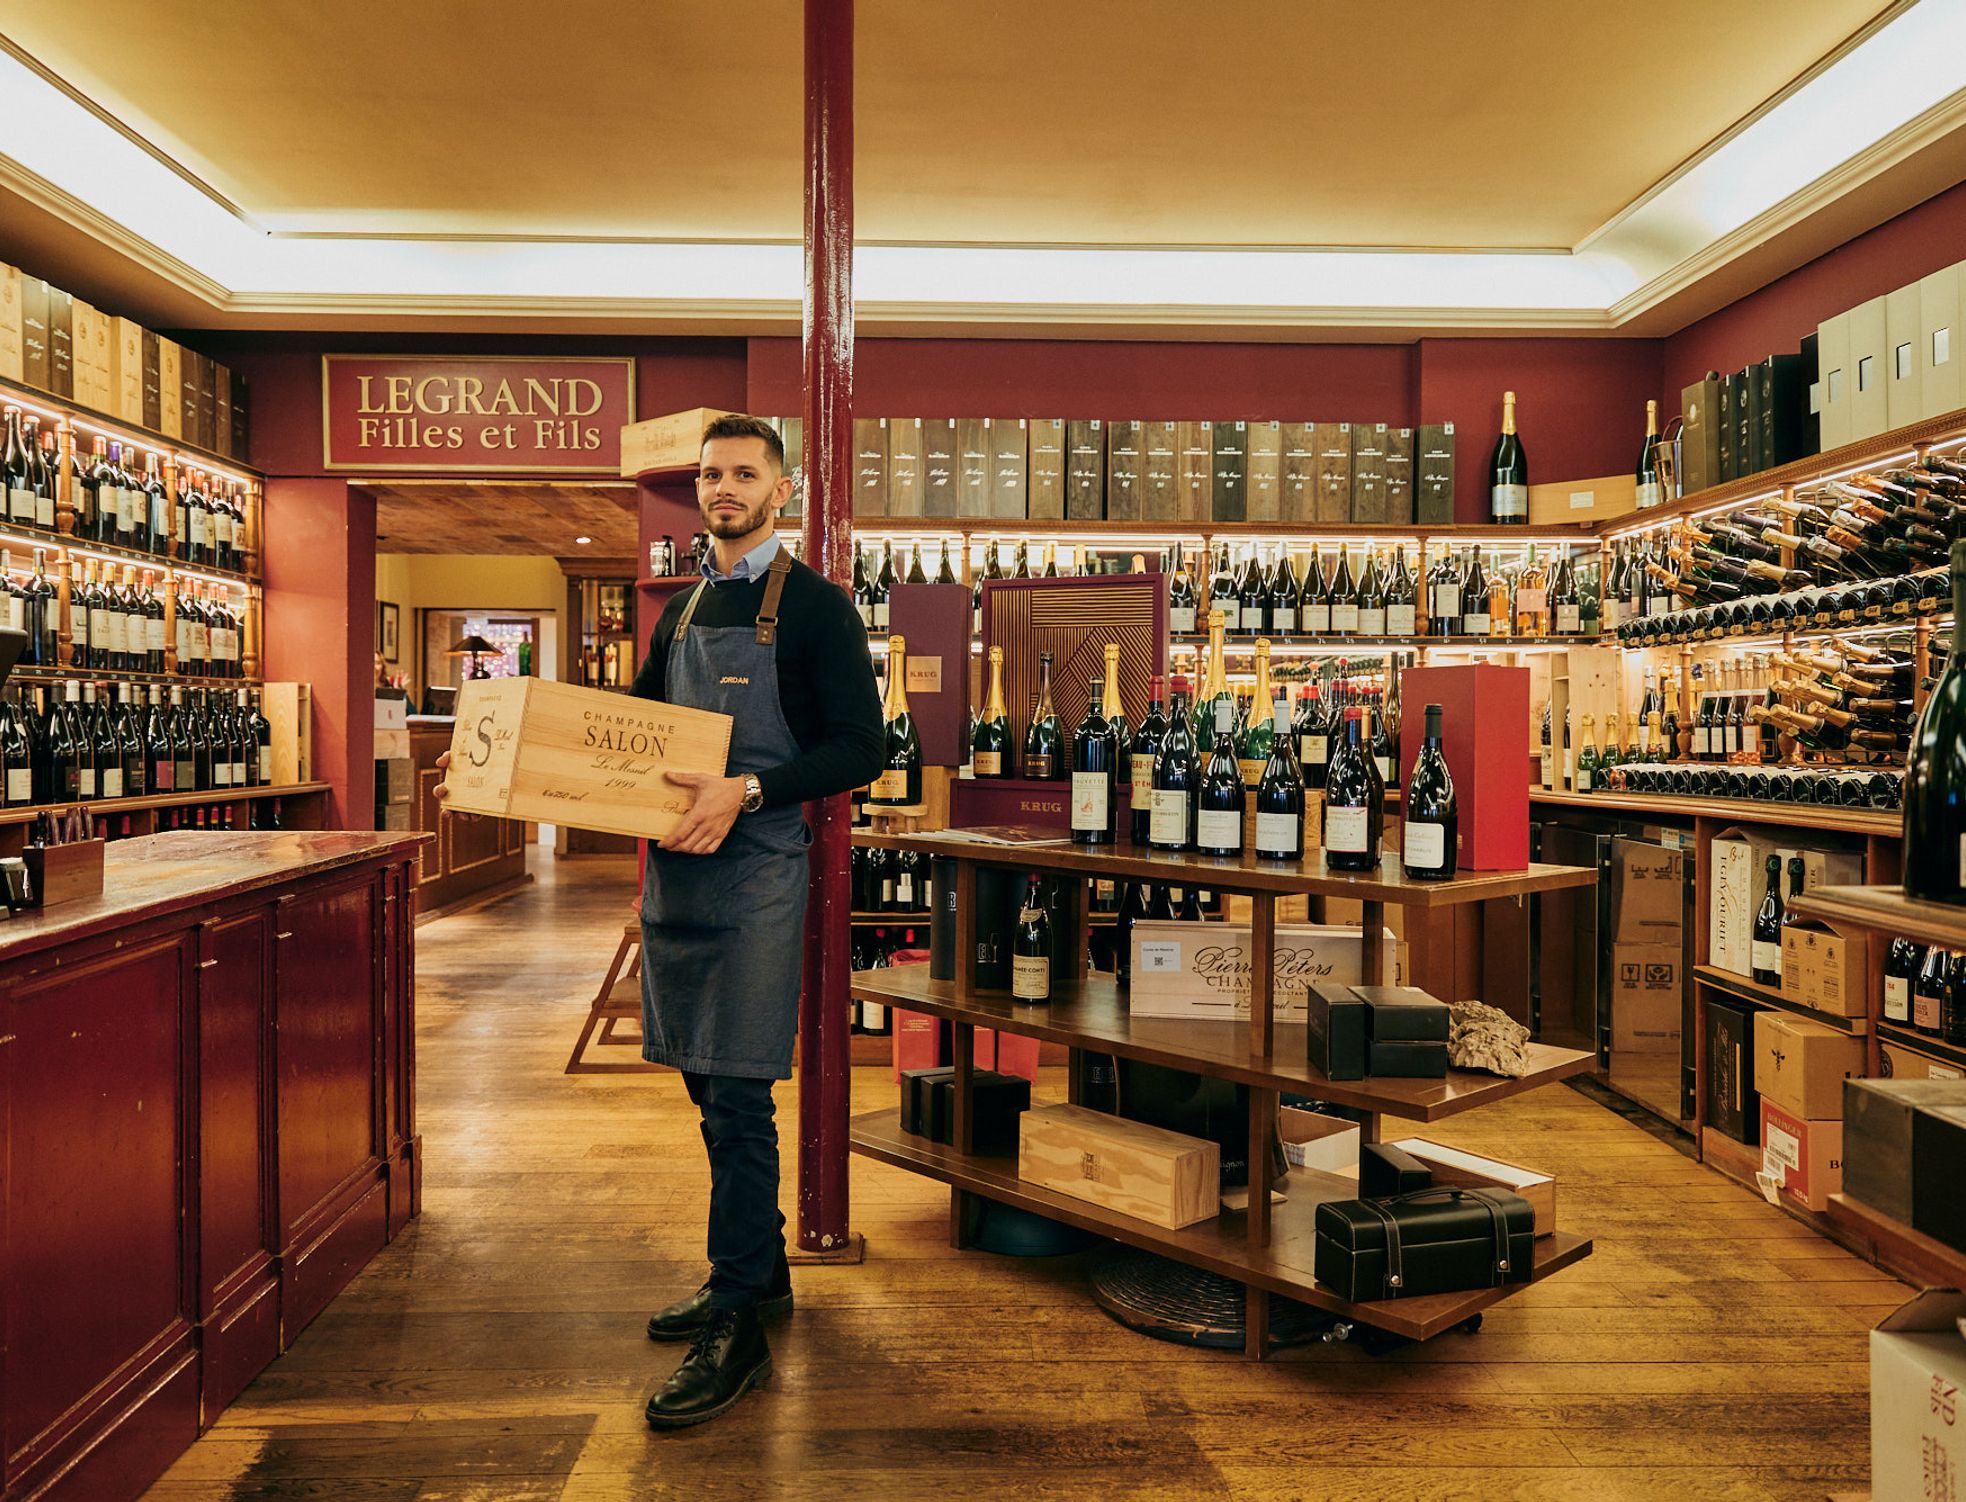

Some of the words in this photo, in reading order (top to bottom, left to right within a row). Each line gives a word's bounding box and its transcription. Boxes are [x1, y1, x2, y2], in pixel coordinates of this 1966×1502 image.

[357, 376, 603, 416] LEGRAND
[358, 418, 464, 448] Filles
[480, 423, 518, 449] et
[534, 420, 601, 450] Fils
[720, 676, 749, 685] JORDAN
[584, 710, 676, 734] CHAMPAGNE
[469, 710, 496, 768] S
[584, 725, 668, 758] SALON
[590, 754, 610, 770] Le
[609, 757, 655, 776] Mesnil
[604, 777, 637, 790] 1999
[1020, 801, 1062, 812] KRUG
[1192, 946, 1252, 978] Pierr
[1930, 1374, 1944, 1416] Fils
